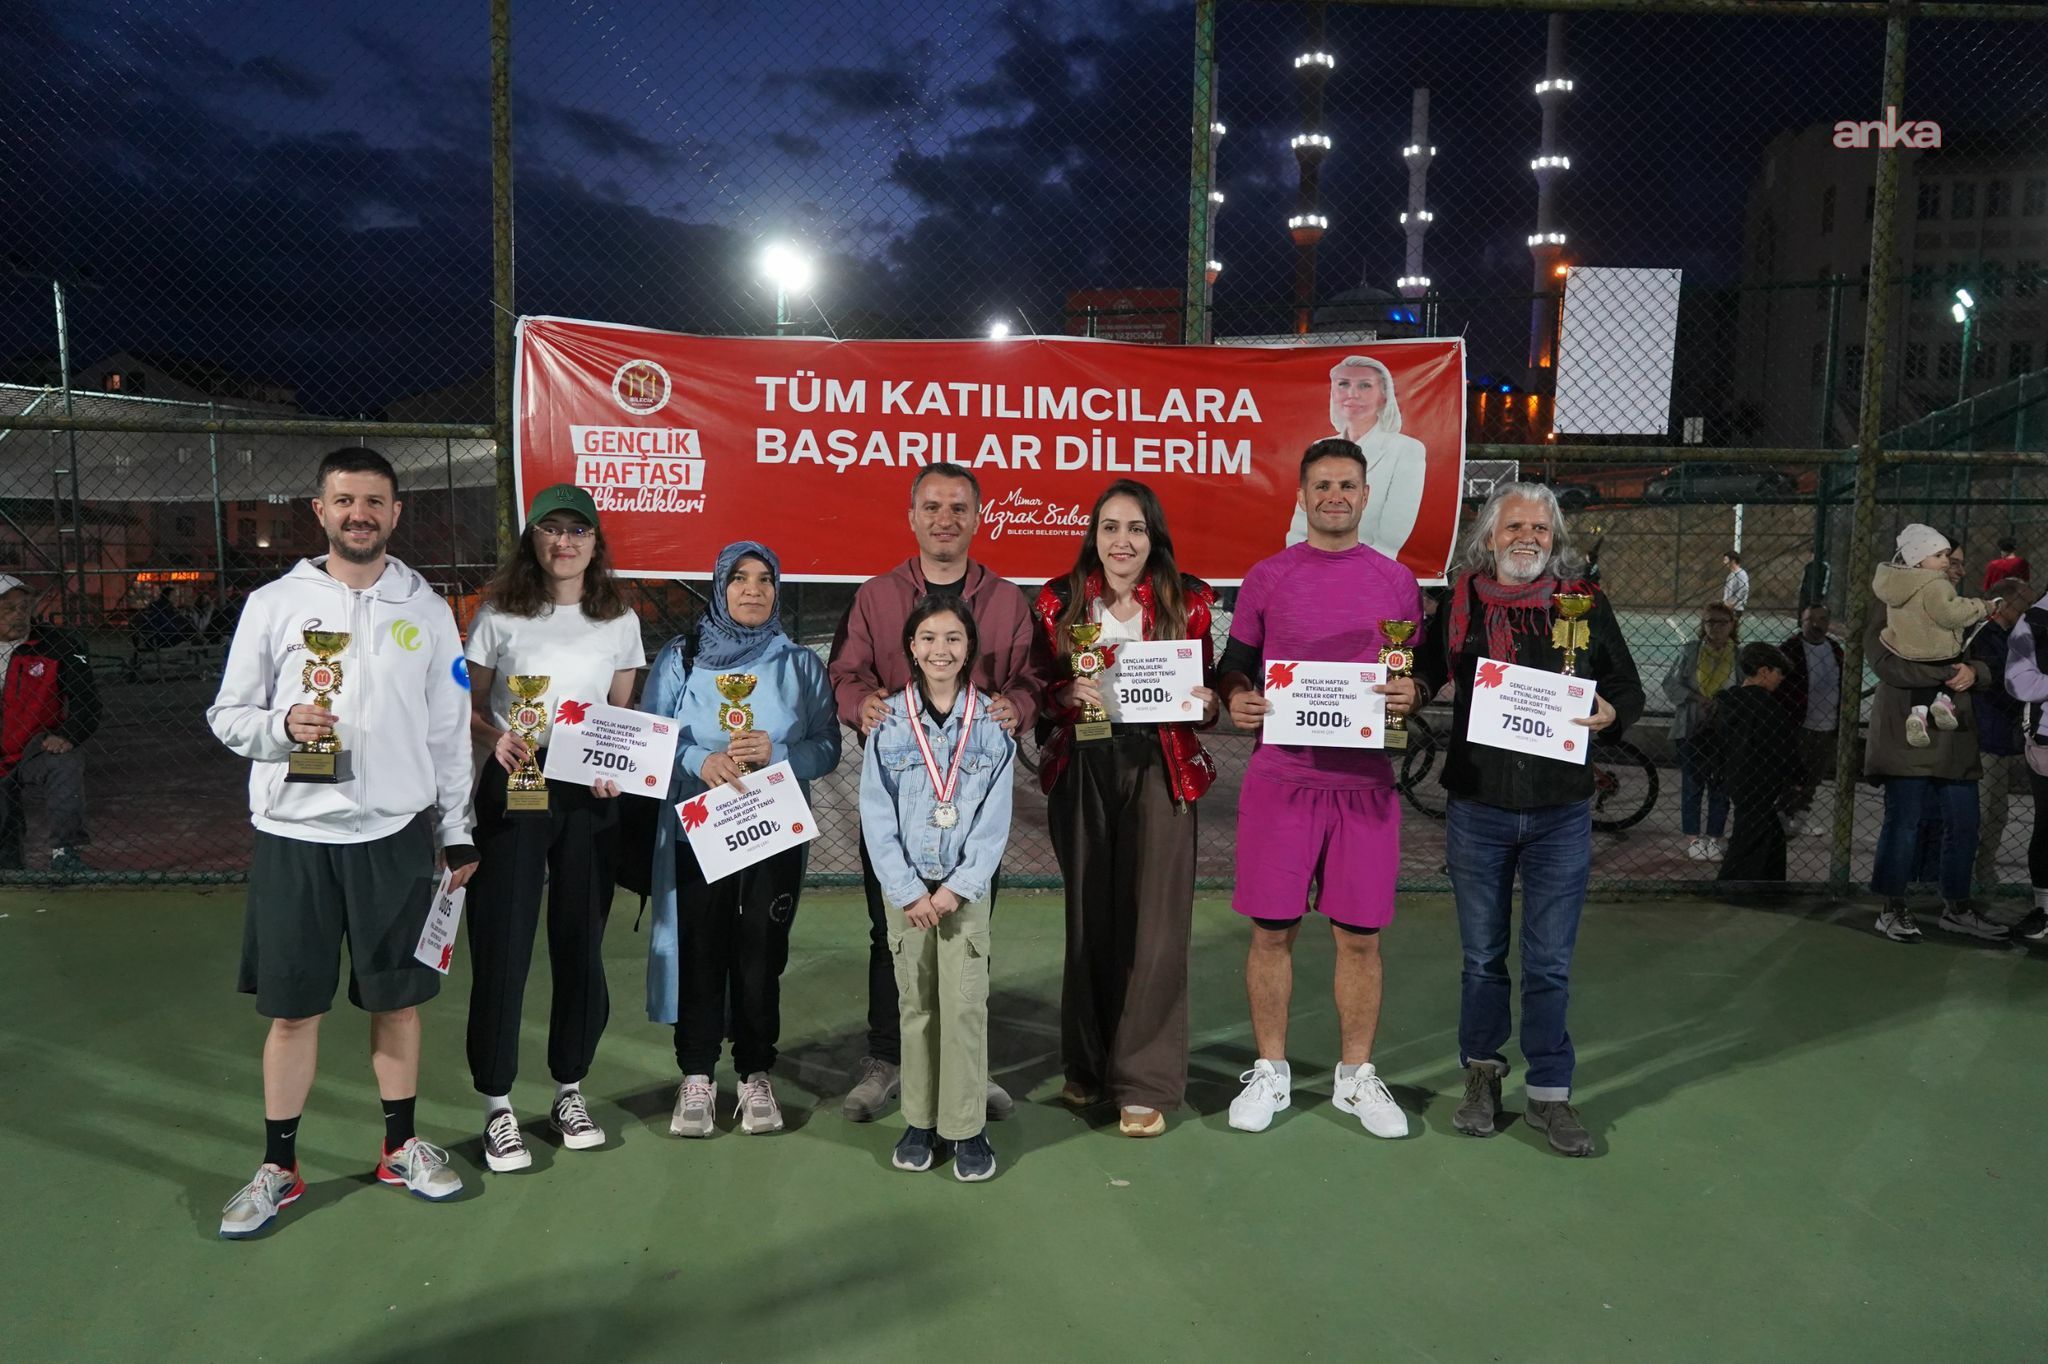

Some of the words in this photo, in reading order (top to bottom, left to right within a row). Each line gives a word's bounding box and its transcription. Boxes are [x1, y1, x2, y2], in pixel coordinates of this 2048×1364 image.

[755, 370, 866, 413] TÜM
[881, 380, 1263, 423] KATILIMCILARA
[584, 427, 691, 460] GENÇLİK
[756, 428, 1042, 473] BAŞARILAR
[1055, 428, 1251, 474] DİLERİM
[585, 461, 690, 485] HAFTASI
[999, 487, 1043, 507] Mimar
[1499, 694, 1528, 705] ERKEKLER
[1528, 701, 1544, 709] KORT
[1533, 687, 1557, 696] HAFTASI
[581, 730, 612, 741] KADINLAR
[612, 735, 628, 744] KORT
[617, 723, 641, 733] HAFTASI
[738, 788, 762, 801] HAFTASI
[713, 812, 742, 828] KADINLAR
[741, 806, 757, 818] KORT
